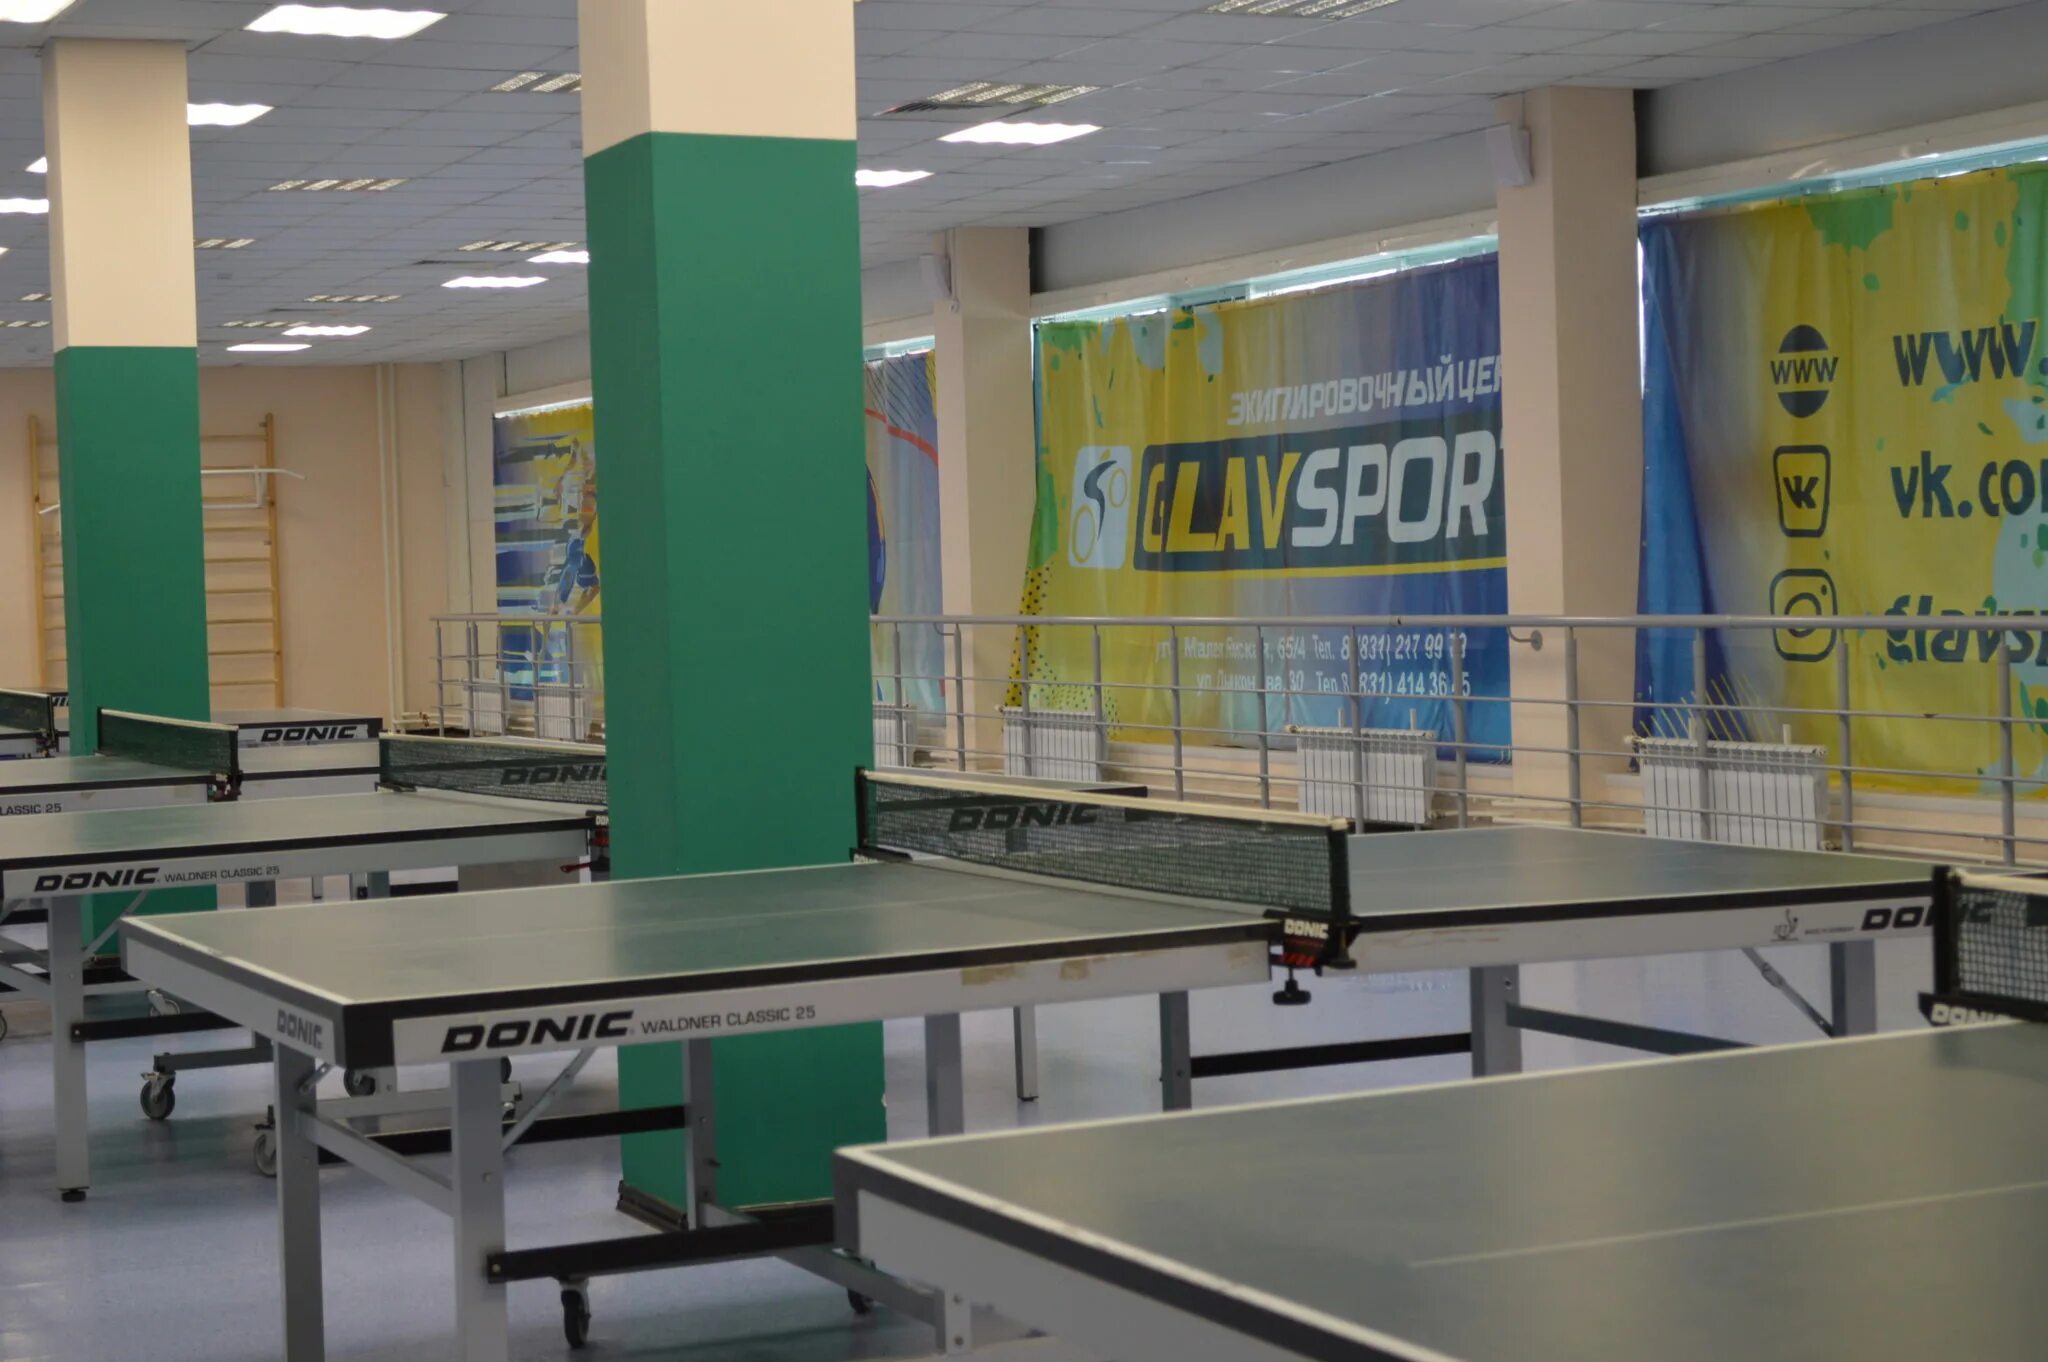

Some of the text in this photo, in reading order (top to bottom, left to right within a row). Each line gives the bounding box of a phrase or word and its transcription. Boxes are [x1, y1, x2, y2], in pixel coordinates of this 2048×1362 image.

[1227, 354, 1455, 425] ЭКИПИРОВОЧНЫЙ
[1141, 429, 1503, 553] GLAVSPOR
[1277, 635, 1305, 659] 65/4
[1341, 635, 1350, 659] 8
[1395, 634, 1420, 659] 217
[1425, 633, 1444, 659] 99
[1397, 671, 1425, 695] 414
[1429, 671, 1448, 695] 36
[260, 725, 358, 742] DONIC
[0, 803, 62, 816] LASSIC 25
[948, 802, 1099, 832] DONIC
[33, 865, 281, 893] DONIC WALDNER CLASSIC 25
[1284, 918, 1329, 939] DONIC
[277, 1007, 323, 1050] DONIC
[441, 1005, 816, 1054] DONIC WALDNER CLASSIC 25
